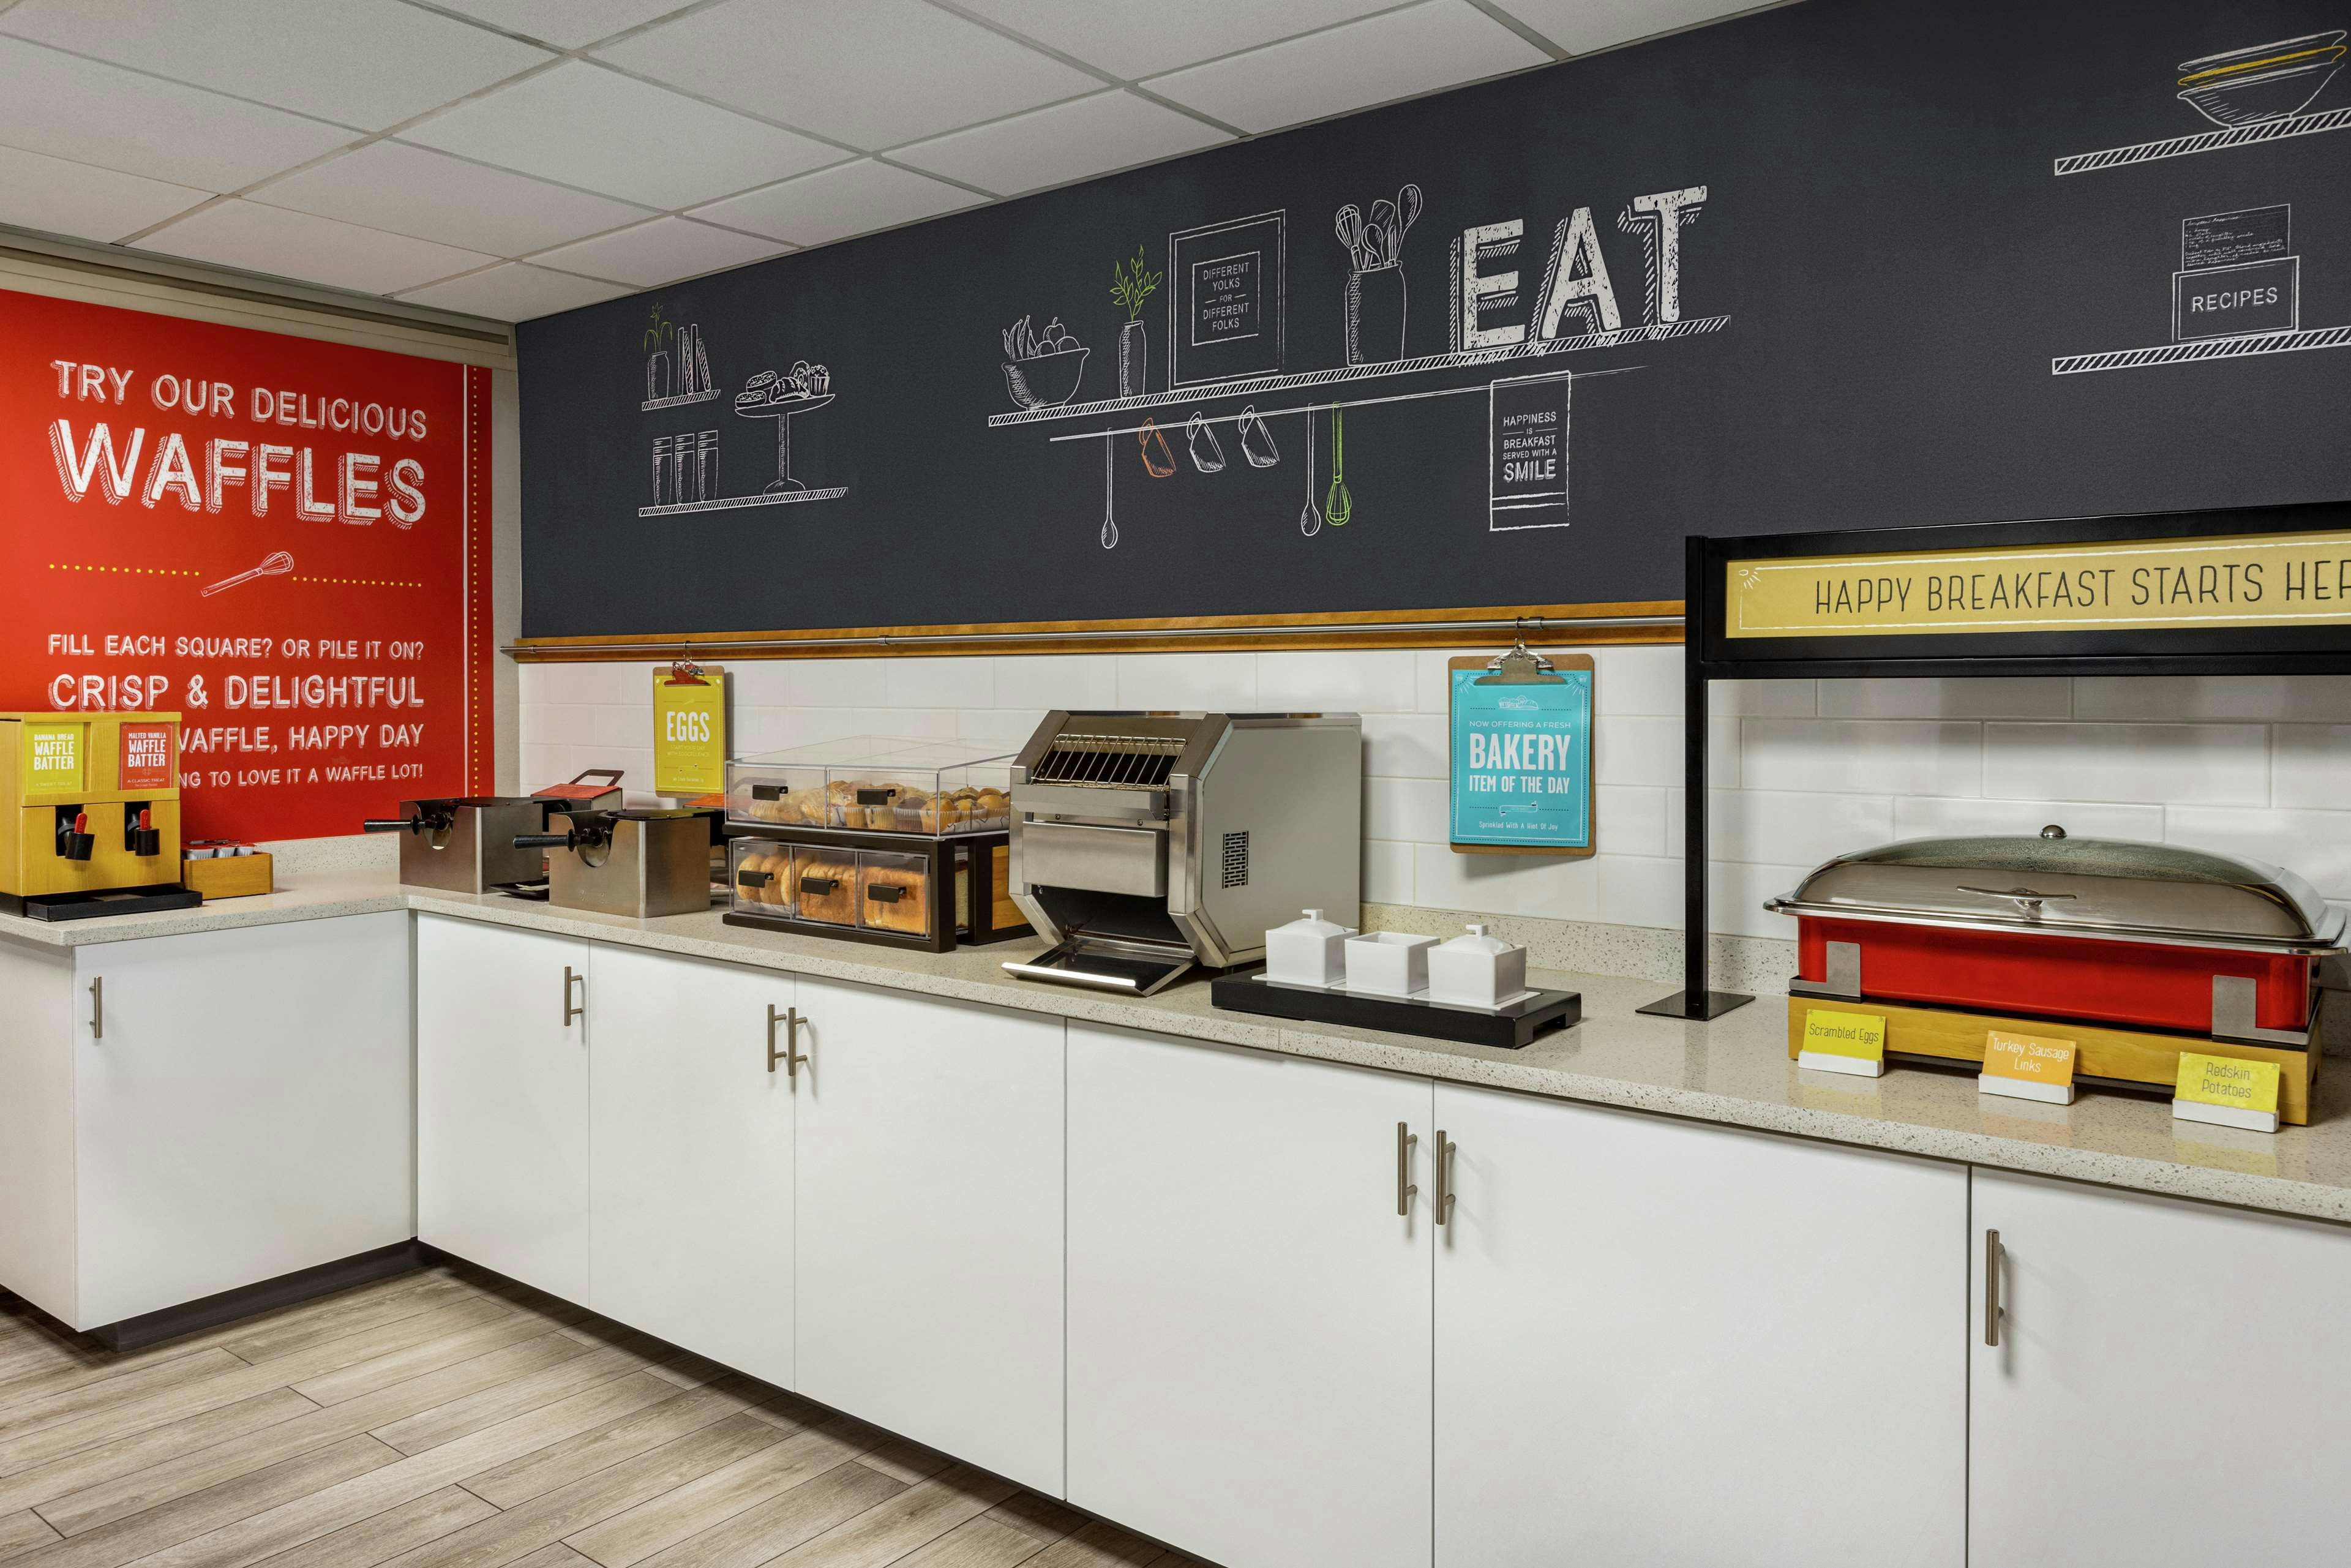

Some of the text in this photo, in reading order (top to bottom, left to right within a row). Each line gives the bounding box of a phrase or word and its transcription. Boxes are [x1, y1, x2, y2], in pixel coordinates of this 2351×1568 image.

[1204, 262, 1250, 280] DIFFERENT
[1449, 185, 1708, 355] EAT
[1212, 277, 1240, 291] YOLKS
[1220, 294, 1232, 303] FOR
[2192, 287, 2278, 313] RECIPES
[1203, 302, 1249, 320] DIFFERENT
[1212, 318, 1239, 332] FOLKS
[50, 359, 427, 441] TRY OUR DELICIOUS
[1503, 411, 1557, 426] HAPPINESS
[1504, 435, 1556, 449] BREAKFAST
[1502, 450, 1529, 460] SERVED
[1532, 449, 1550, 457] WITH
[49, 419, 426, 530] WAFFLES
[1503, 459, 1556, 482] SMILE
[1815, 577, 1914, 614] HAPPY
[1927, 569, 2115, 612] BREAKFAST
[2131, 563, 2263, 606] STARTS
[48, 634, 424, 660] FILL EACH SQUARE? OR PILE IT ON?
[48, 673, 424, 711] CRISP & DELIGHTFUL
[666, 711, 710, 742] EGGS
[129, 739, 167, 753] WAFFLE
[289, 725, 370, 751] HAPPY
[380, 724, 424, 748] DAY
[34, 741, 75, 756] WAFFLE
[1469, 733, 1571, 771] BAKERY
[34, 756, 74, 770] BATTER
[128, 754, 166, 767] BATTER
[208, 770, 230, 787] TO
[238, 768, 280, 787] LOVE
[287, 768, 301, 784] IT
[307, 768, 318, 784] A
[325, 765, 385, 783] WAFFLE
[391, 763, 423, 780] LOT!
[1469, 775, 1570, 794] ITEM OF THE DAY
[1809, 1023, 1879, 1045] Scrambled Eggs
[1993, 1037, 2069, 1062] Turkey Sausage
[2014, 1057, 2041, 1073] Links
[2206, 1062, 2250, 1080] Redskin
[2202, 1079, 2252, 1098] Potatoes
